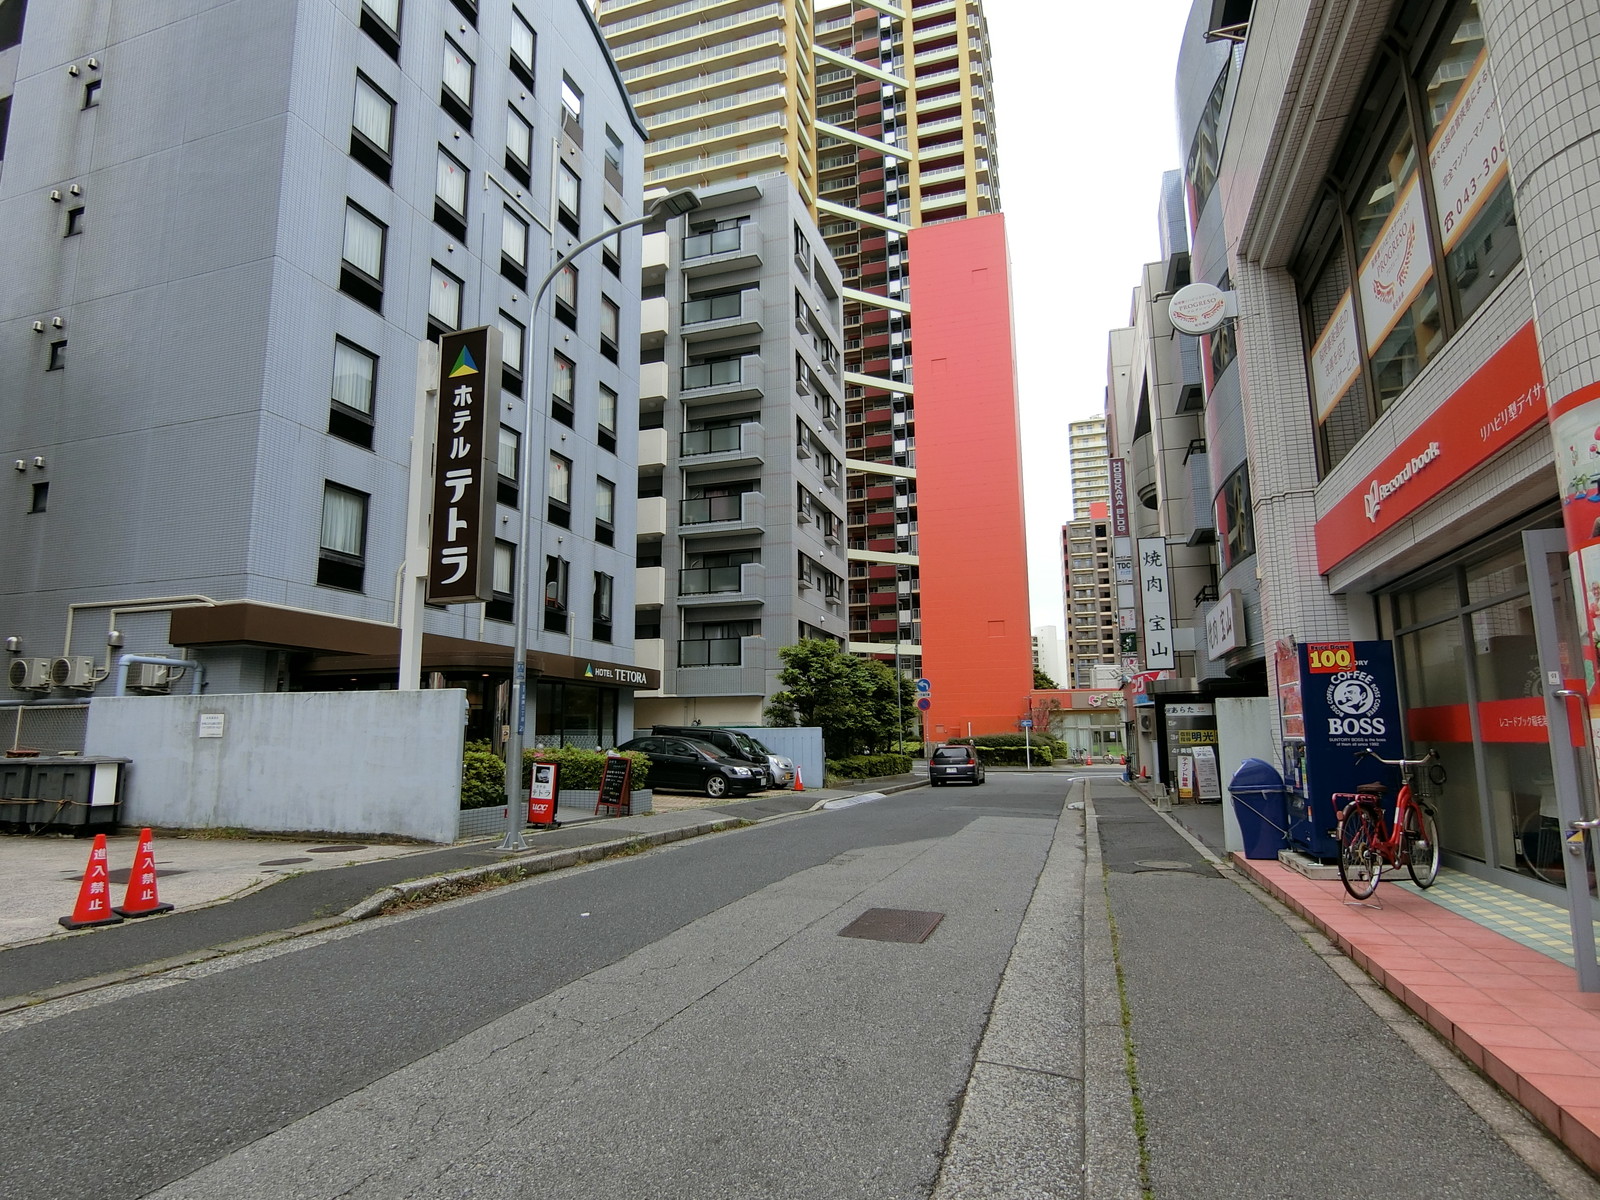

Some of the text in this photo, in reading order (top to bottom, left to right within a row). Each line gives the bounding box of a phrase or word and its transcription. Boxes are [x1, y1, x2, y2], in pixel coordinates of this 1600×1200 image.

[1376, 222, 1408, 277] PROGRESO
[1179, 297, 1217, 312] PROGRESO
[1479, 382, 1546, 442] リハビリ型デイサ
[440, 384, 473, 585] ホテル テトラ
[1113, 461, 1124, 506] HOSOKAWA
[1379, 441, 1441, 501] Record book
[1142, 550, 1168, 657] 焼肉 宝山
[595, 668, 647, 684] HOTEL TETORA
[1310, 650, 1351, 668] 100
[1330, 670, 1374, 684] COFFEE
[1191, 732, 1214, 742] 明光
[1327, 718, 1386, 735] BOSS
[532, 803, 549, 811] UCC
[89, 848, 107, 911] 進入禁止
[141, 841, 154, 900] 進入禁止
